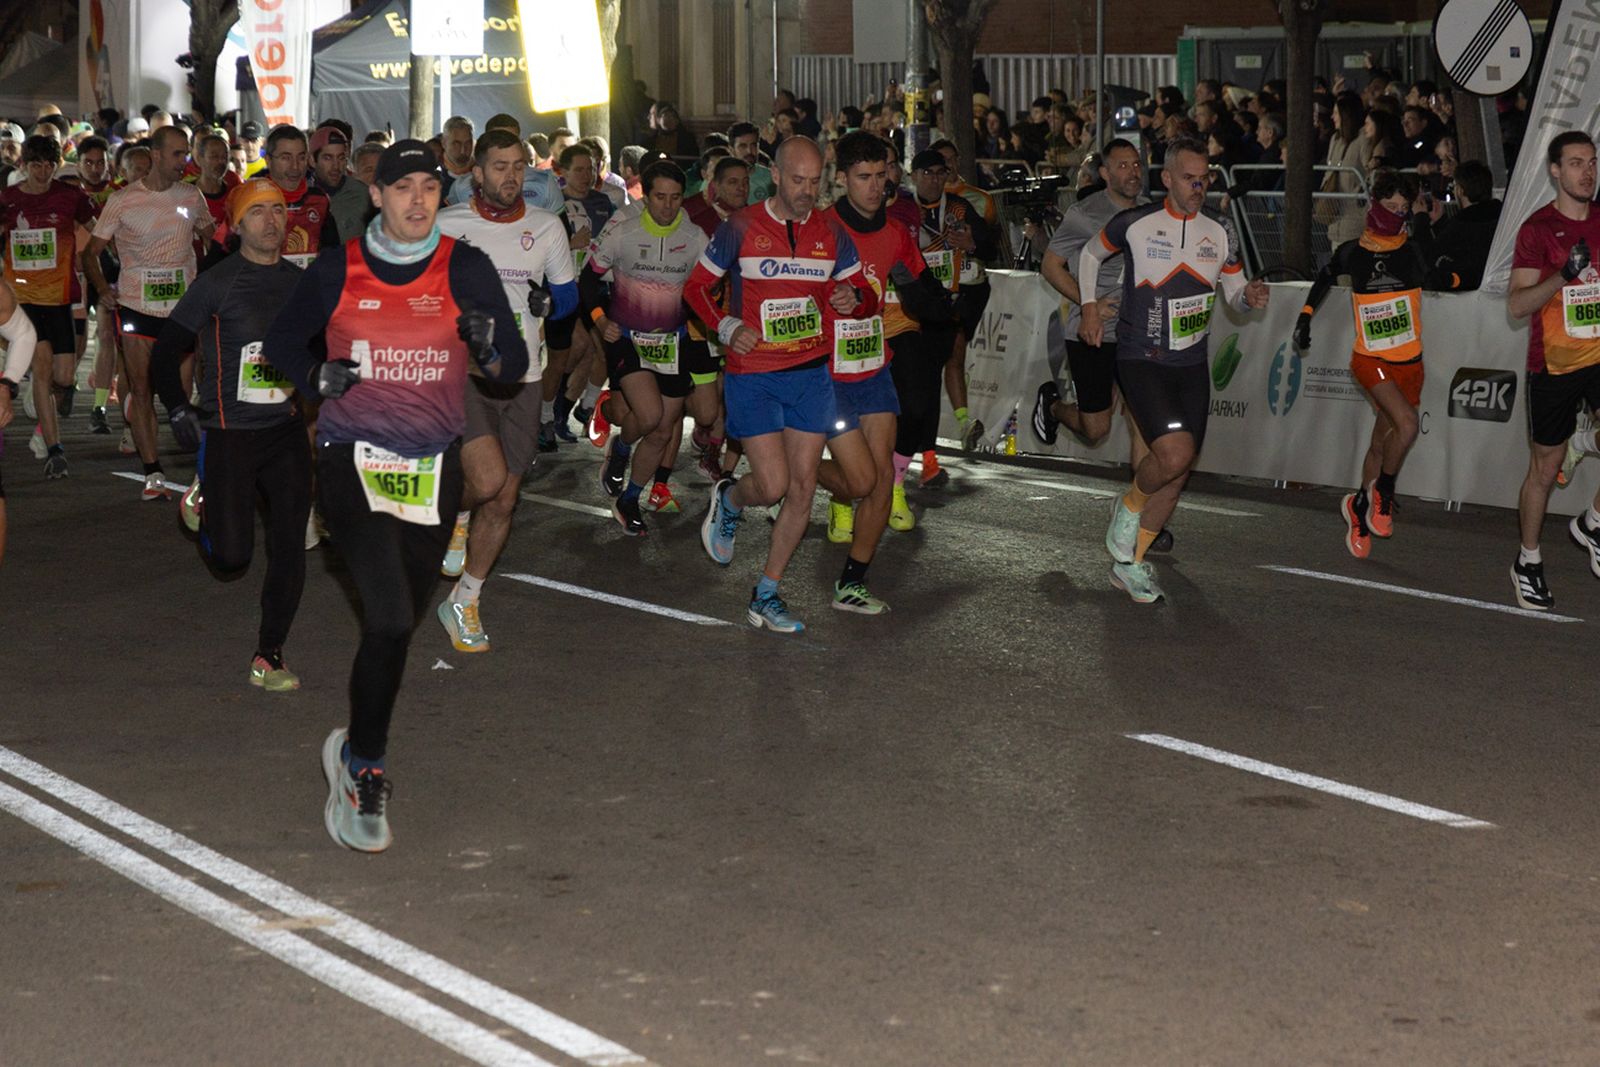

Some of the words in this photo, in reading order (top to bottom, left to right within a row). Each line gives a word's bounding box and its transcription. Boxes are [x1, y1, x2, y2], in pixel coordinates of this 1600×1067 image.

[781, 263, 825, 277] Avanza
[151, 283, 180, 297] 2562
[769, 314, 816, 336] 13065
[1367, 313, 1408, 335] 13985
[847, 336, 877, 355] 5582
[1452, 379, 1511, 411] 42K
[373, 472, 420, 497] 1651
